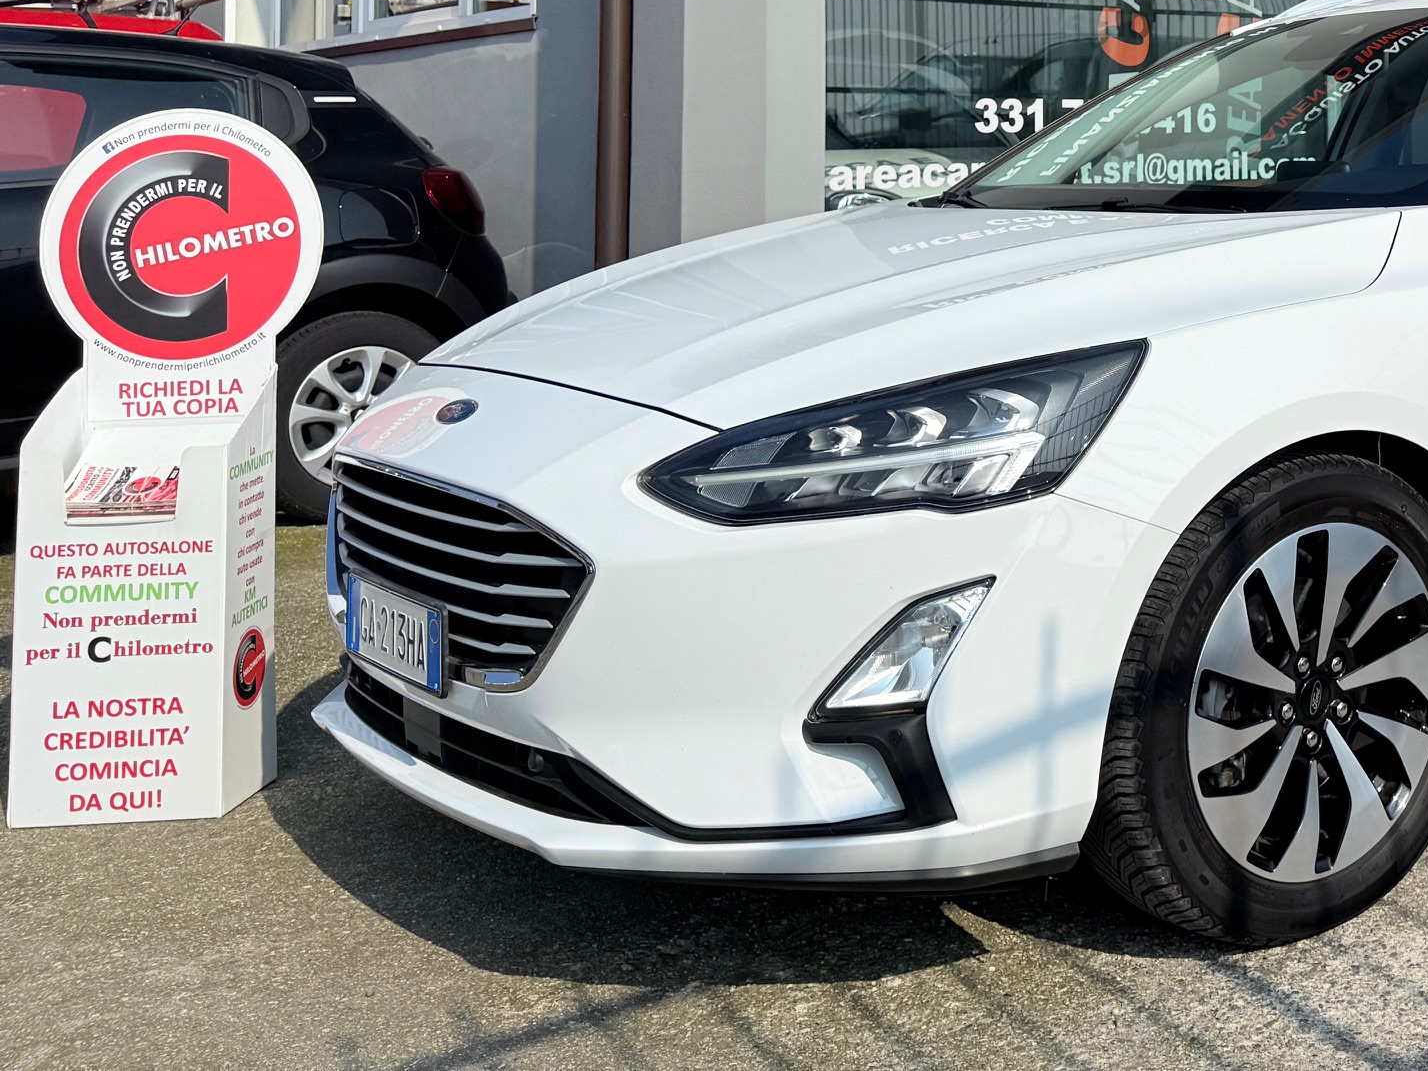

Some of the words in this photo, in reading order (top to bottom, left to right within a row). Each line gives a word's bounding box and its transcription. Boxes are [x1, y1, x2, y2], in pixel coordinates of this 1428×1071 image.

[974, 98, 1044, 134] 331
[114, 133, 136, 148] Non
[137, 121, 192, 140] prendermi
[193, 121, 211, 132] per
[213, 121, 220, 132] il
[221, 126, 271, 157] Chilometro
[177, 178, 207, 194] PER
[209, 183, 223, 199] IL
[110, 181, 173, 246] PRENDERMI
[110, 250, 131, 282] NON
[93, 332, 267, 372] www.nonprendermiperilchilometro.it
[118, 379, 210, 400] RICHIEDI
[218, 378, 243, 395] LA
[122, 400, 167, 418] TUA
[173, 397, 240, 416] COPIA
[230, 449, 274, 480] COMMUNITY
[245, 527, 255, 538] con
[29, 542, 99, 560] QUESTO
[103, 539, 214, 556] AUTOSALONE
[57, 566, 78, 579] FA
[81, 564, 132, 578] PARTE
[137, 562, 187, 577] DELLA
[245, 576, 255, 586] con
[44, 581, 199, 604] COMMUNITY
[244, 586, 256, 604] KM
[42, 612, 84, 629] Non
[90, 607, 198, 632] prendermi
[231, 595, 268, 628] AUTENTICI
[25, 646, 60, 665] per
[66, 642, 81, 659] il
[87, 636, 214, 663] Chilometro
[52, 700, 80, 719] LA
[87, 696, 184, 718] NOSTRA
[54, 758, 178, 781] COMINCIA
[69, 793, 102, 812] DA
[109, 789, 163, 812] QUI!
